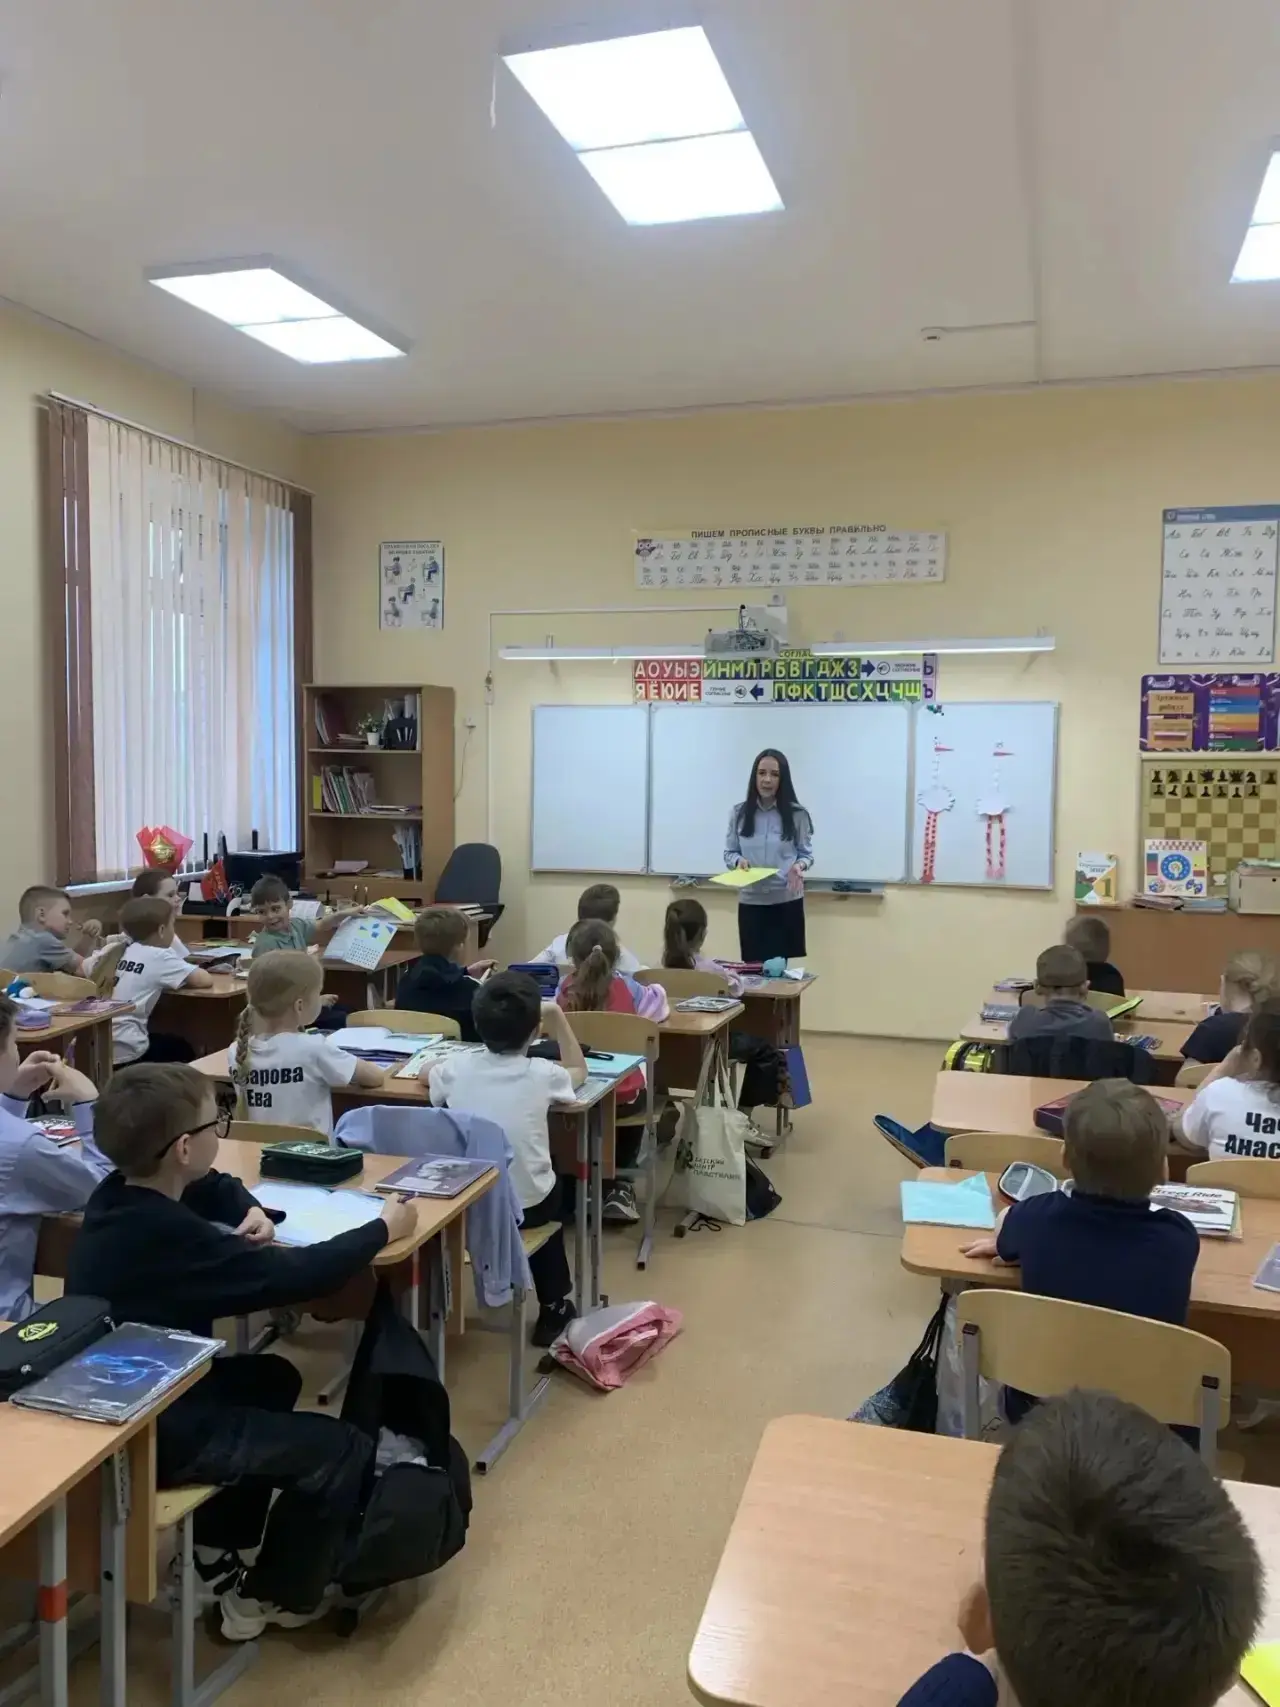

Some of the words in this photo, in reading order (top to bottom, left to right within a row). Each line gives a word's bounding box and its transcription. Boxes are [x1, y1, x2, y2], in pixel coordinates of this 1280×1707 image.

[691, 530, 725, 539] ПИШЕМ
[729, 528, 788, 537] ПРОПИСНЫЕ
[793, 527, 825, 535] БУКВЫ
[829, 525, 887, 534] ПРАВИЛЬНО
[1101, 878, 1113, 898] 1
[115, 960, 145, 975] ова
[246, 1089, 273, 1108] Ева
[1192, 1191, 1223, 1199] Ride
